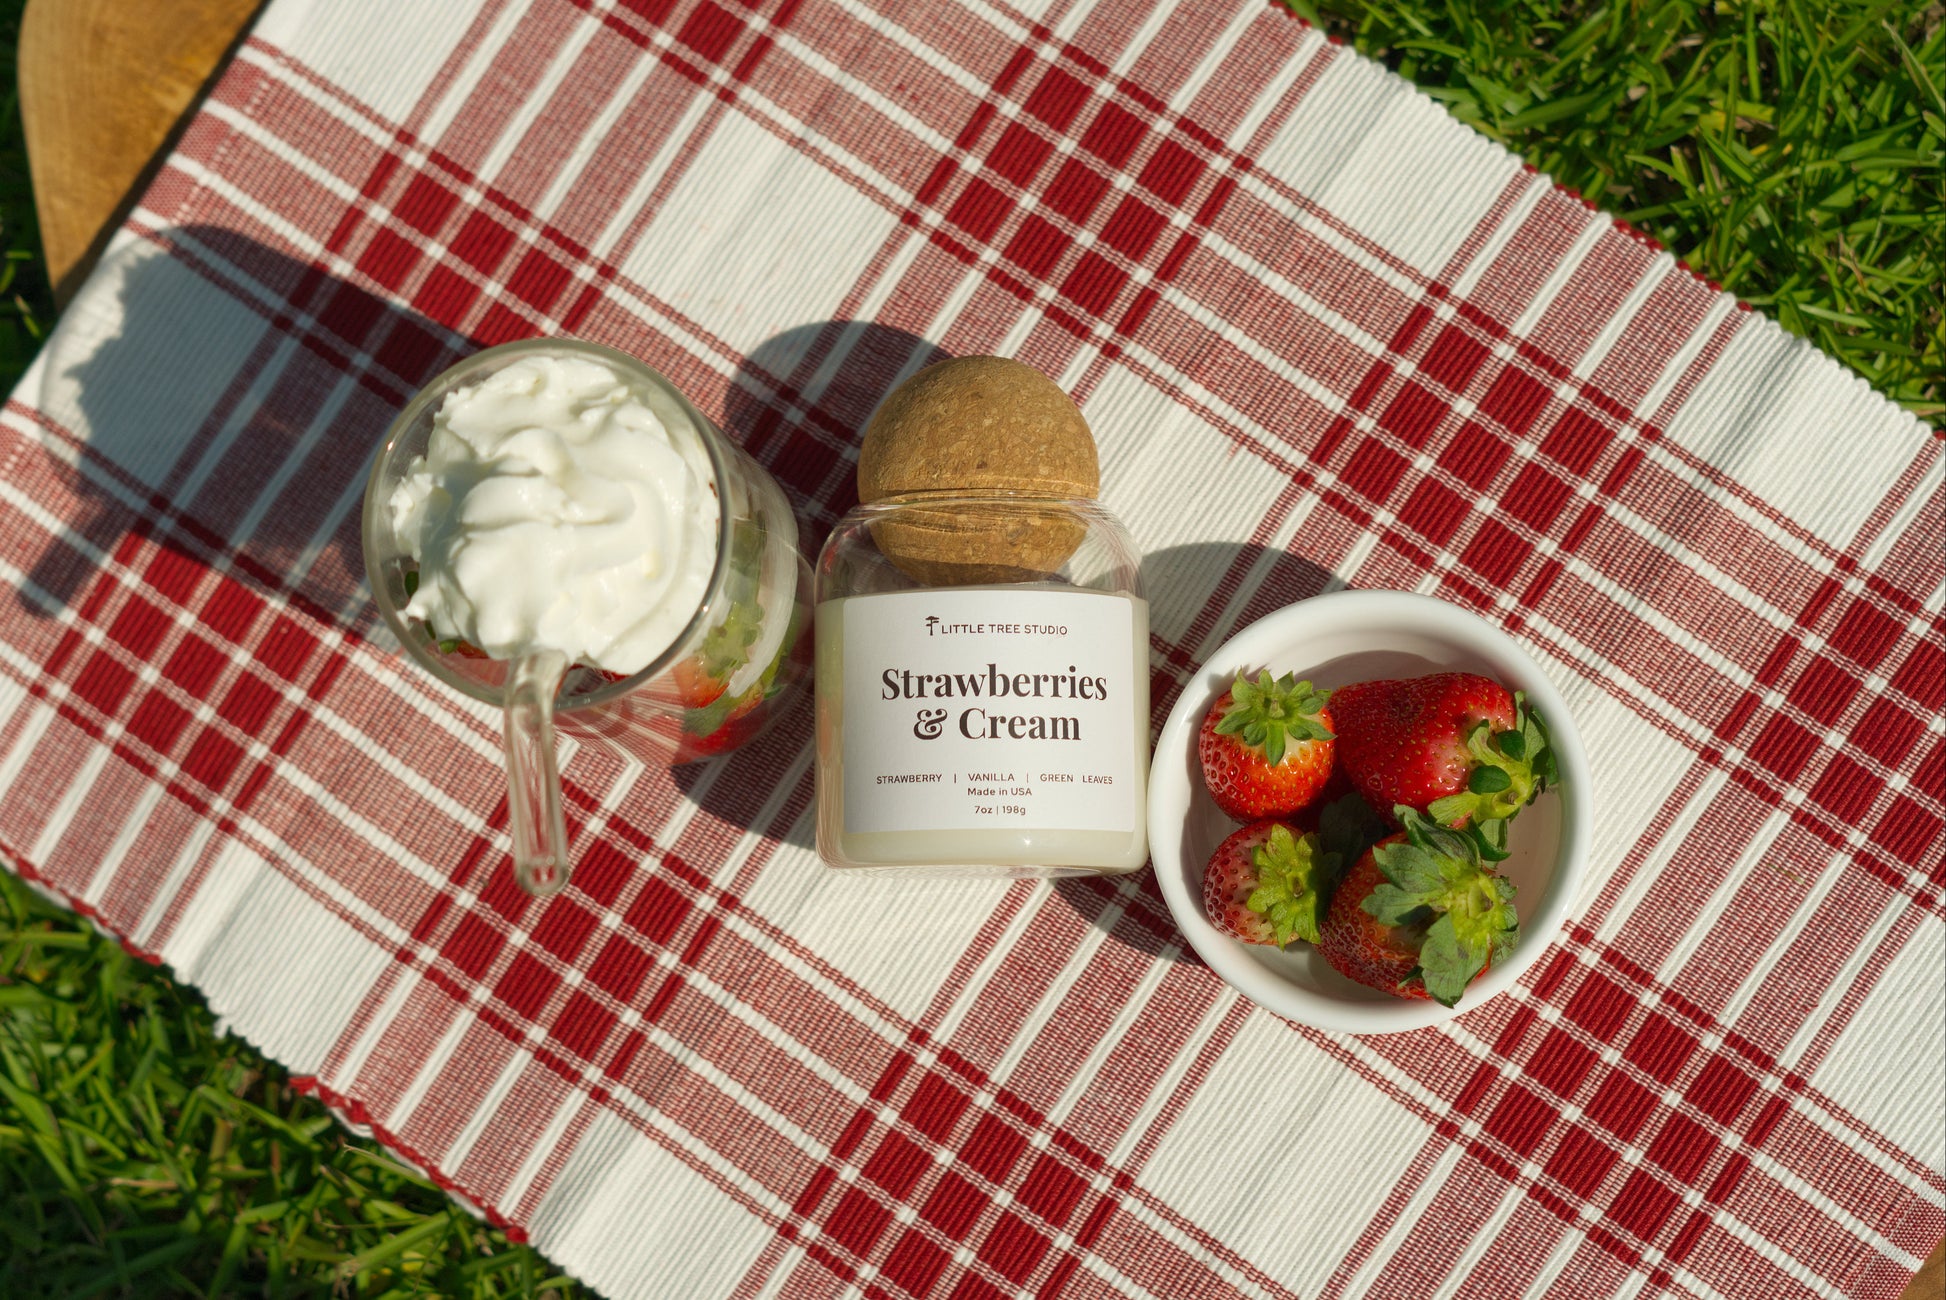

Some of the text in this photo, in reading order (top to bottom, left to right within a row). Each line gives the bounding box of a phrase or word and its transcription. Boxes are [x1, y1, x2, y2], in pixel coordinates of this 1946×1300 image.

[941, 623, 1068, 636] LITTLE TREE STUDIO
[881, 663, 1108, 701] Strawberries
[913, 707, 1082, 741] & Cream
[876, 773, 942, 785] STRAWBERRY
[967, 773, 1015, 783] VANILLA
[1039, 773, 1074, 783] GREEN
[1082, 775, 1113, 785] LEAVES
[967, 787, 1033, 796] Made in USA
[974, 805, 993, 815] 7oz
[1002, 805, 1026, 816] 198g
